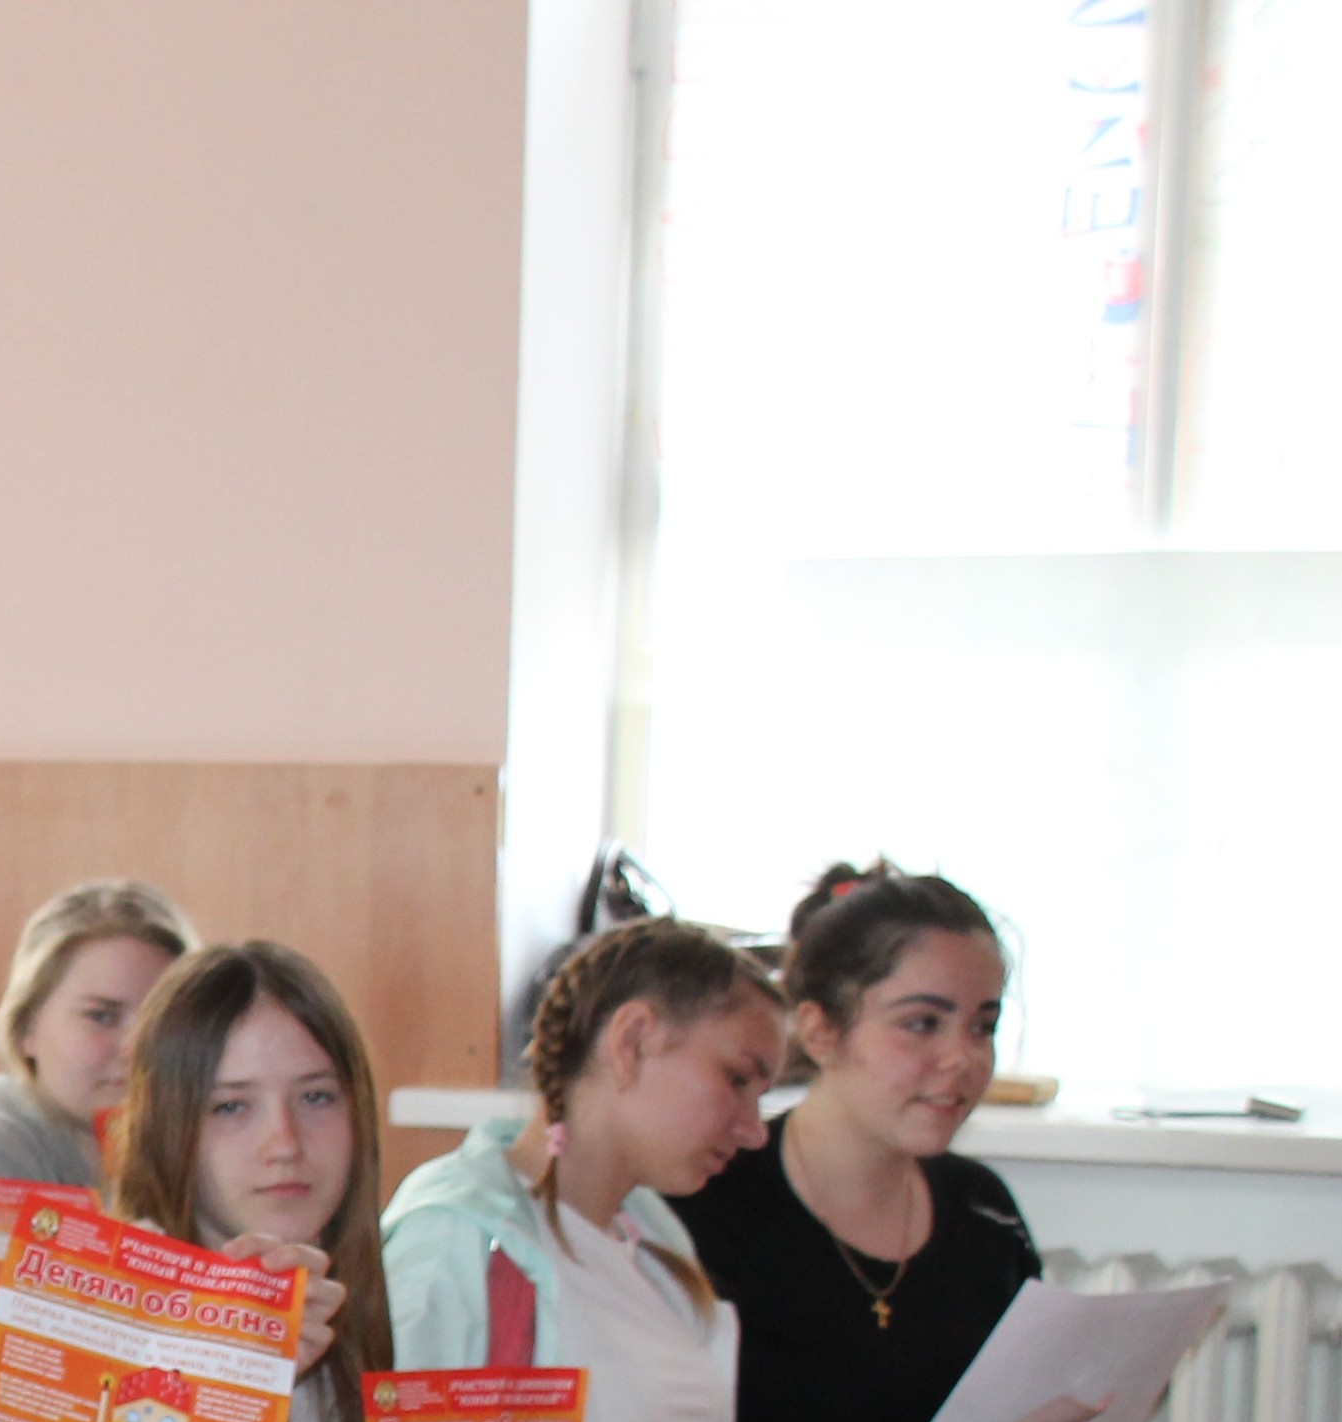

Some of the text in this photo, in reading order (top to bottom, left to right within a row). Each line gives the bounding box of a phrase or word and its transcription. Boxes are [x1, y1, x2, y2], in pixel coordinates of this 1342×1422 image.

[13, 1244, 286, 1341] Детям об огне
